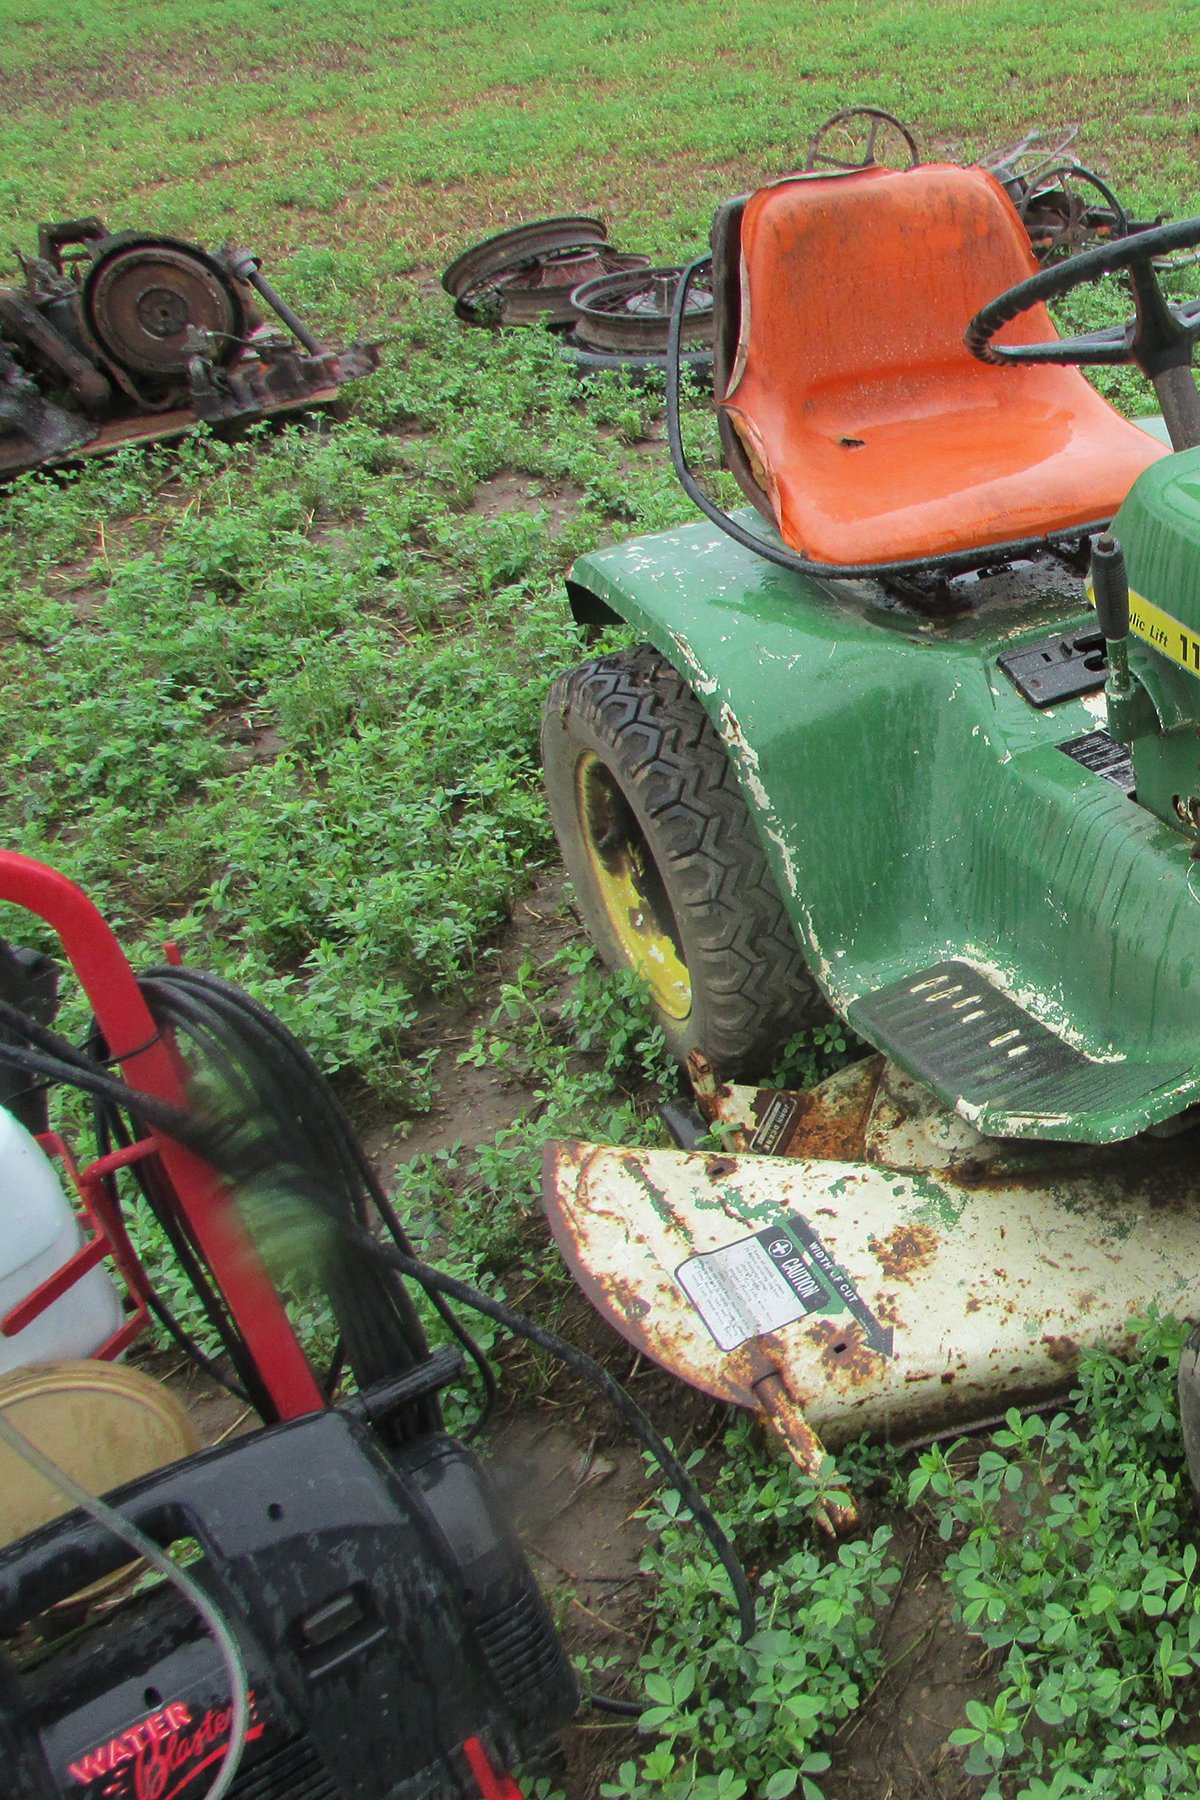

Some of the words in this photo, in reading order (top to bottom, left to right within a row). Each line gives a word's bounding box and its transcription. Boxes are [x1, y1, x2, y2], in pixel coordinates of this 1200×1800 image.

[1149, 625, 1169, 648] Lift
[781, 1257, 821, 1299] CAUTION
[808, 1241, 834, 1270] WIDTH
[840, 1283, 859, 1303] CUT
[67, 1701, 193, 1785] WATER
